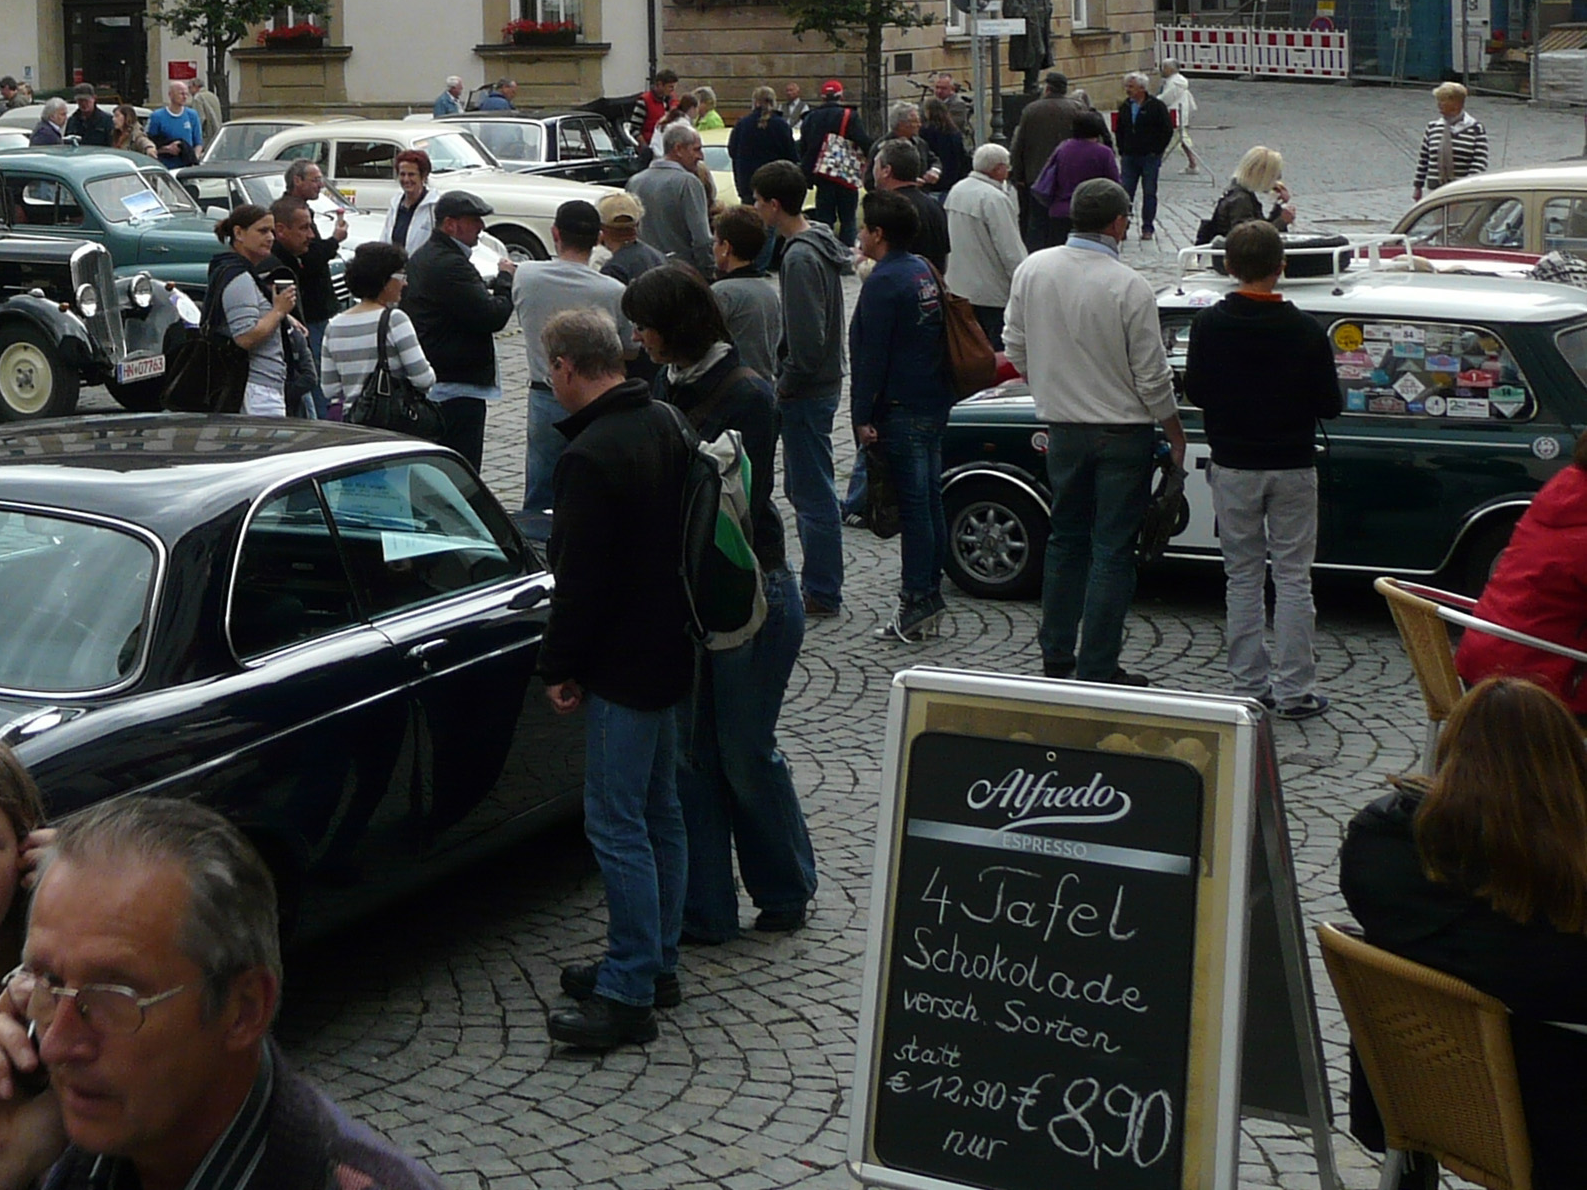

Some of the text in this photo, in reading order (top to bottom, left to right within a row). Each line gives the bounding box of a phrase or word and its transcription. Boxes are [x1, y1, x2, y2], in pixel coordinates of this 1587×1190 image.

[966, 767, 1132, 821] Alfredo
[1002, 832, 1088, 859] ESPRESSO
[920, 865, 1140, 942] 4 Tafel
[903, 926, 1149, 1013] Schokolade
[904, 988, 1122, 1054] versch. Sorten
[893, 1034, 963, 1069] statt
[884, 1070, 1008, 1110] € 12,90
[942, 1128, 1009, 1161] nur
[1047, 1076, 1174, 1171] 8,90
